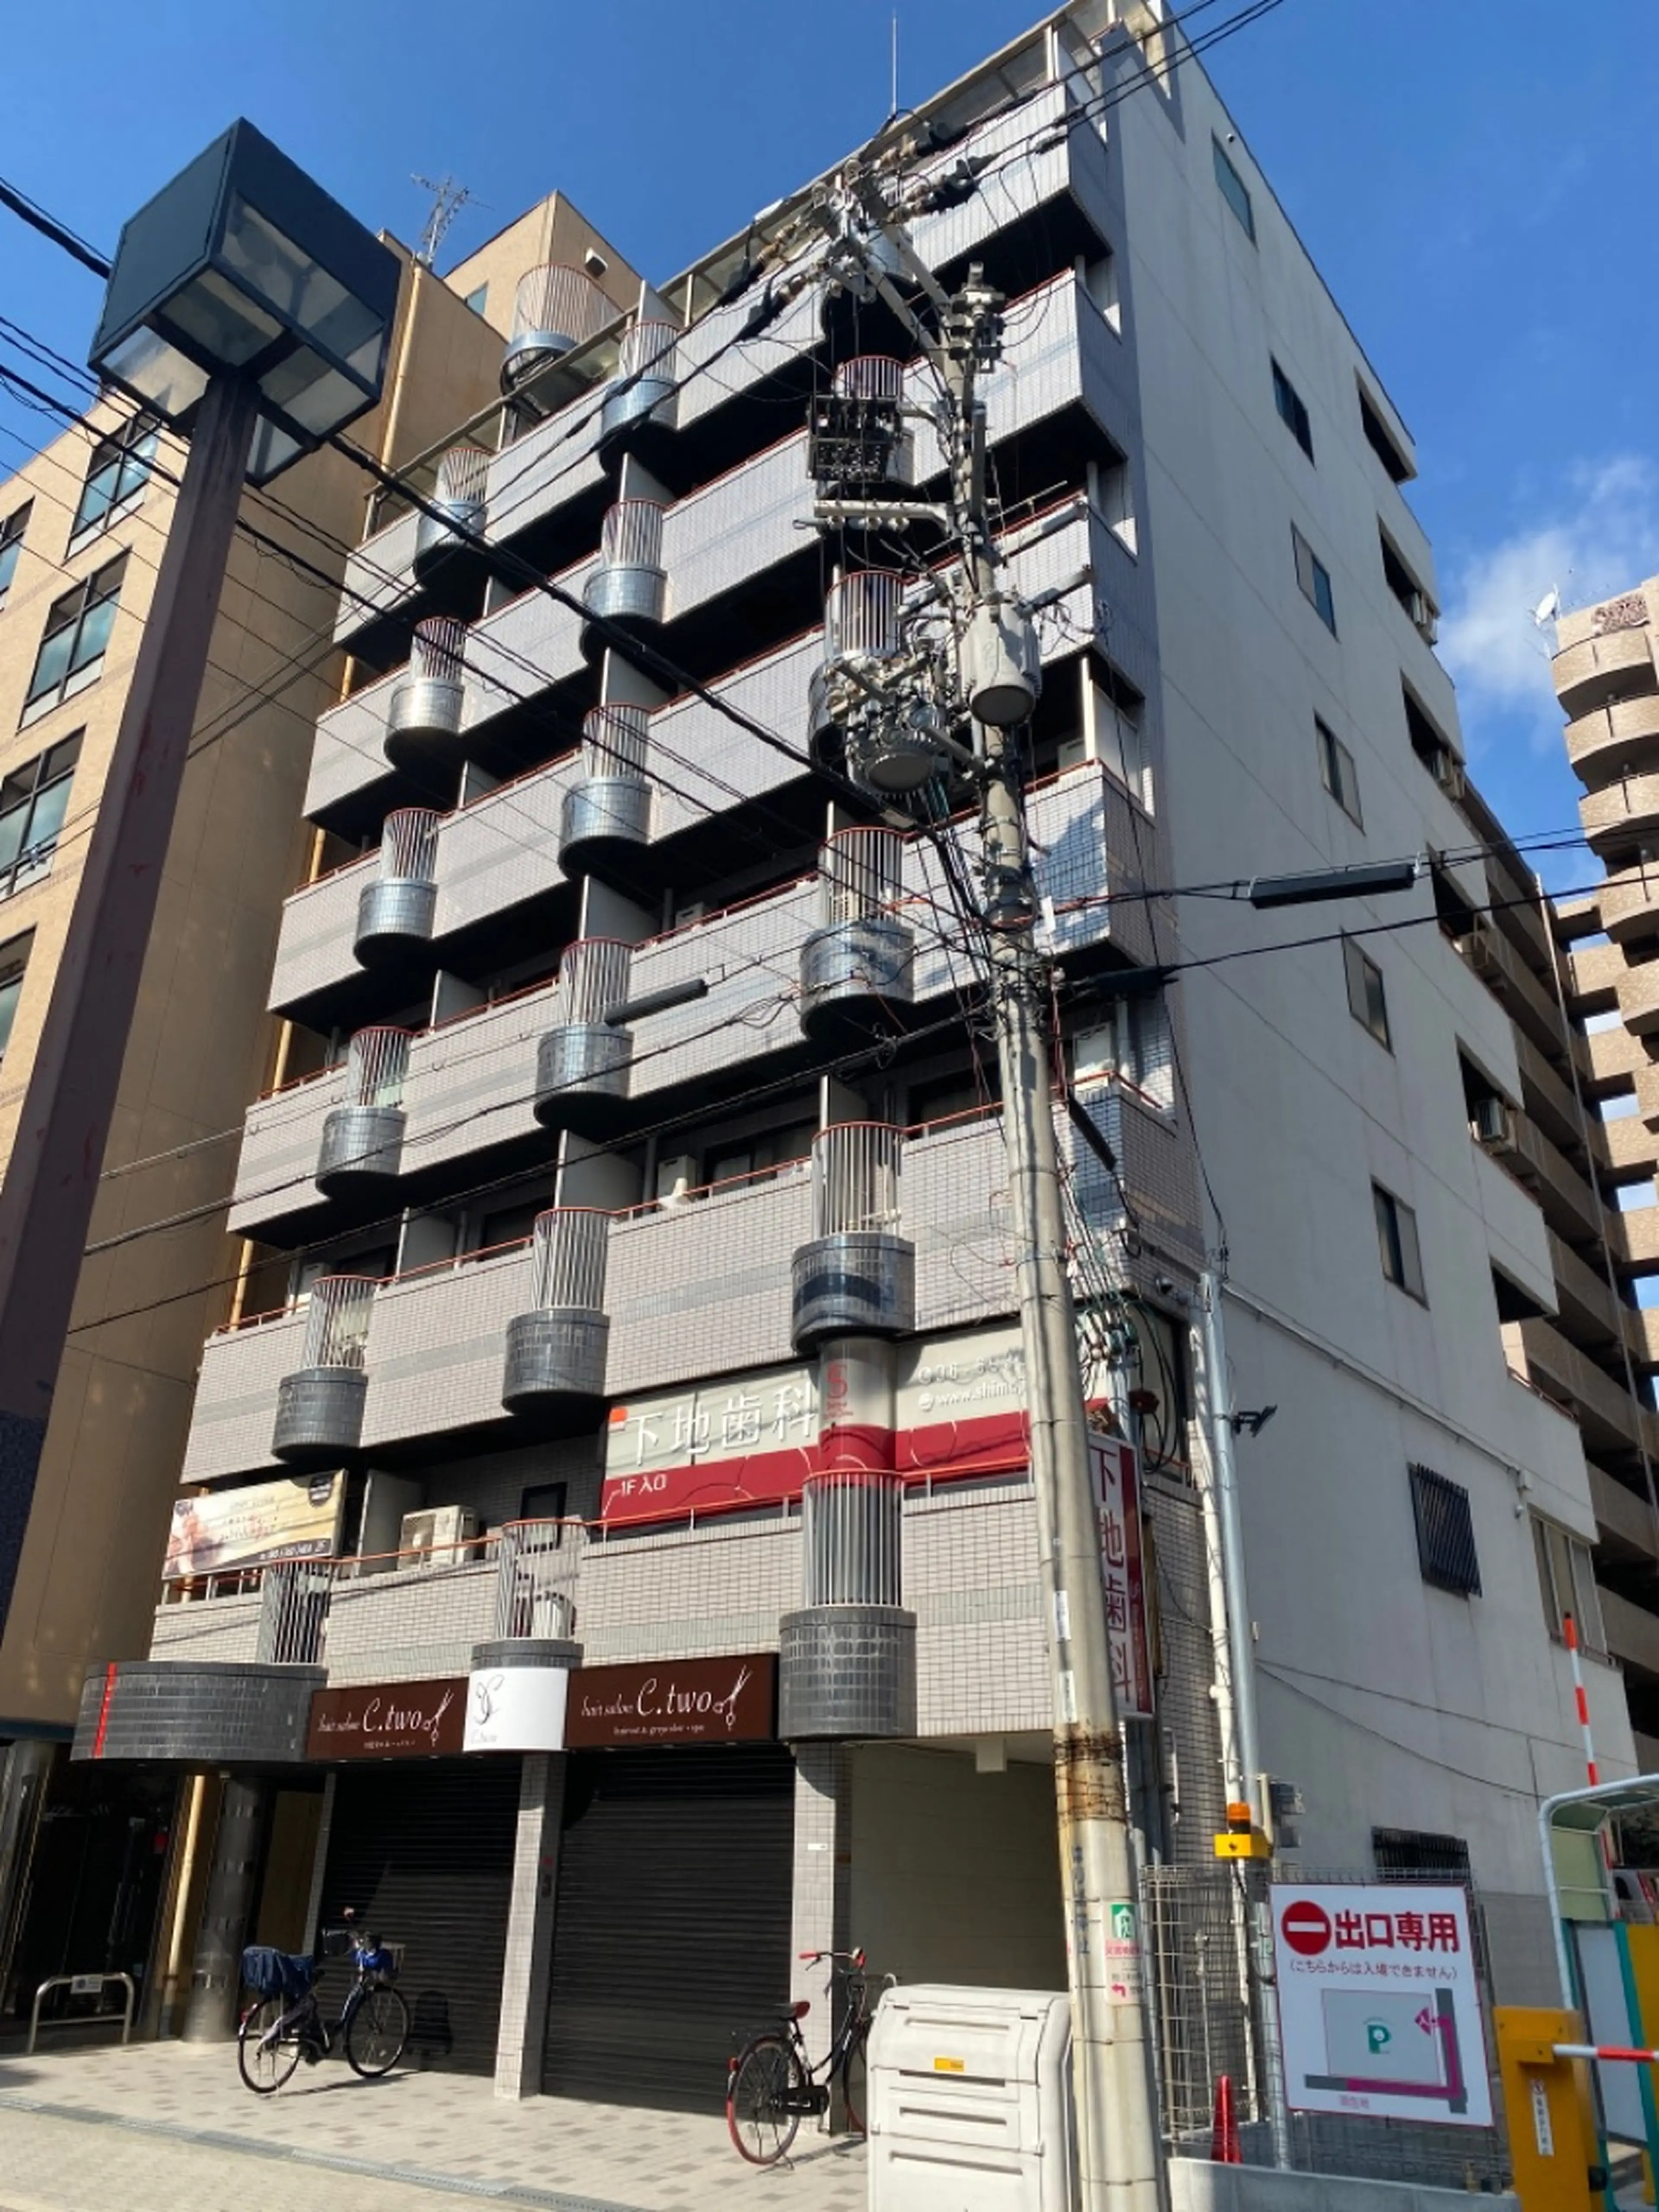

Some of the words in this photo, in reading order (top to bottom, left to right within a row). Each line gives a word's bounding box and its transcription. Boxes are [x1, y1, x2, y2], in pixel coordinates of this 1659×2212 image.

[625, 1382, 816, 1467] 下地歯科
[637, 1678, 712, 1716] C.two
[1335, 1908, 1460, 1953] 出口専用
